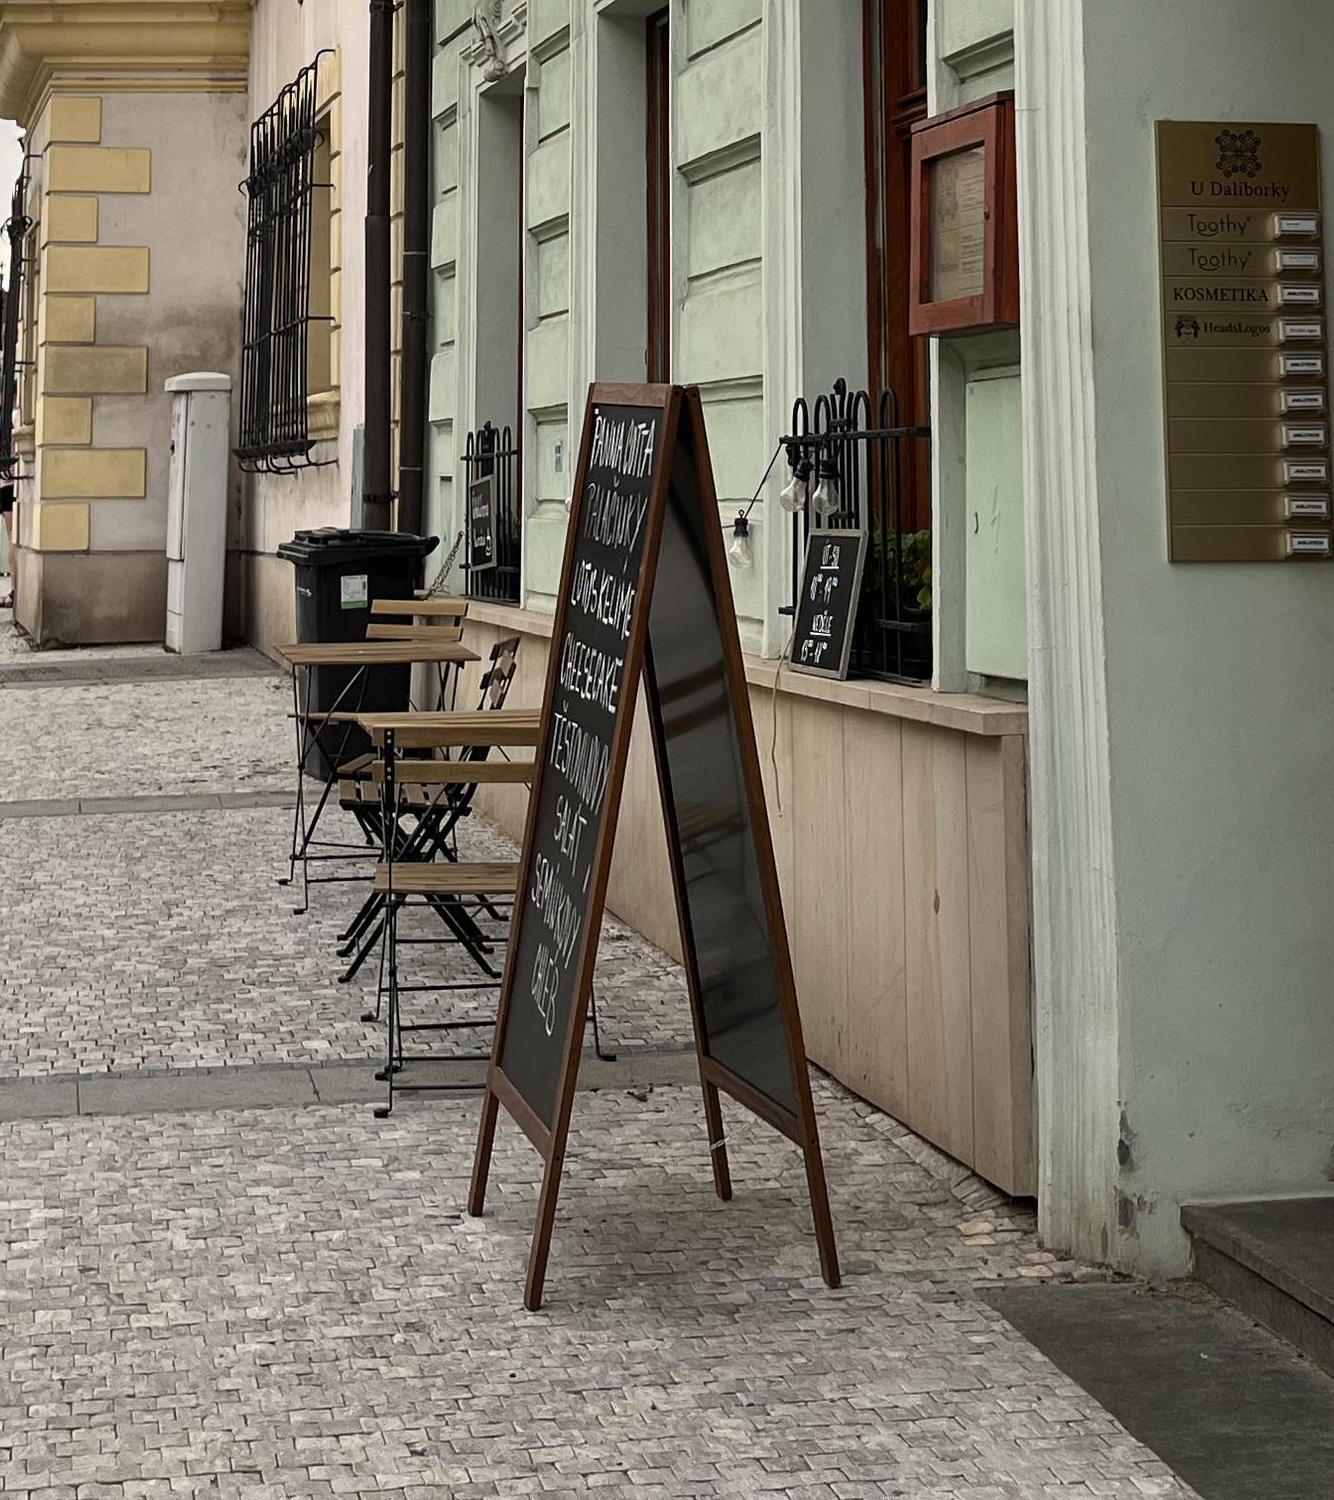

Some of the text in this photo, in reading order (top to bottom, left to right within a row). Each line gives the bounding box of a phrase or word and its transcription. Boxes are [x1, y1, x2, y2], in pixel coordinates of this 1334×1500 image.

[1191, 180, 1291, 203] U Daliborky
[1173, 286, 1269, 302] KOSMETIKA
[1203, 321, 1271, 338] HeadsLogos
[560, 632, 624, 715] CHEESECAKE
